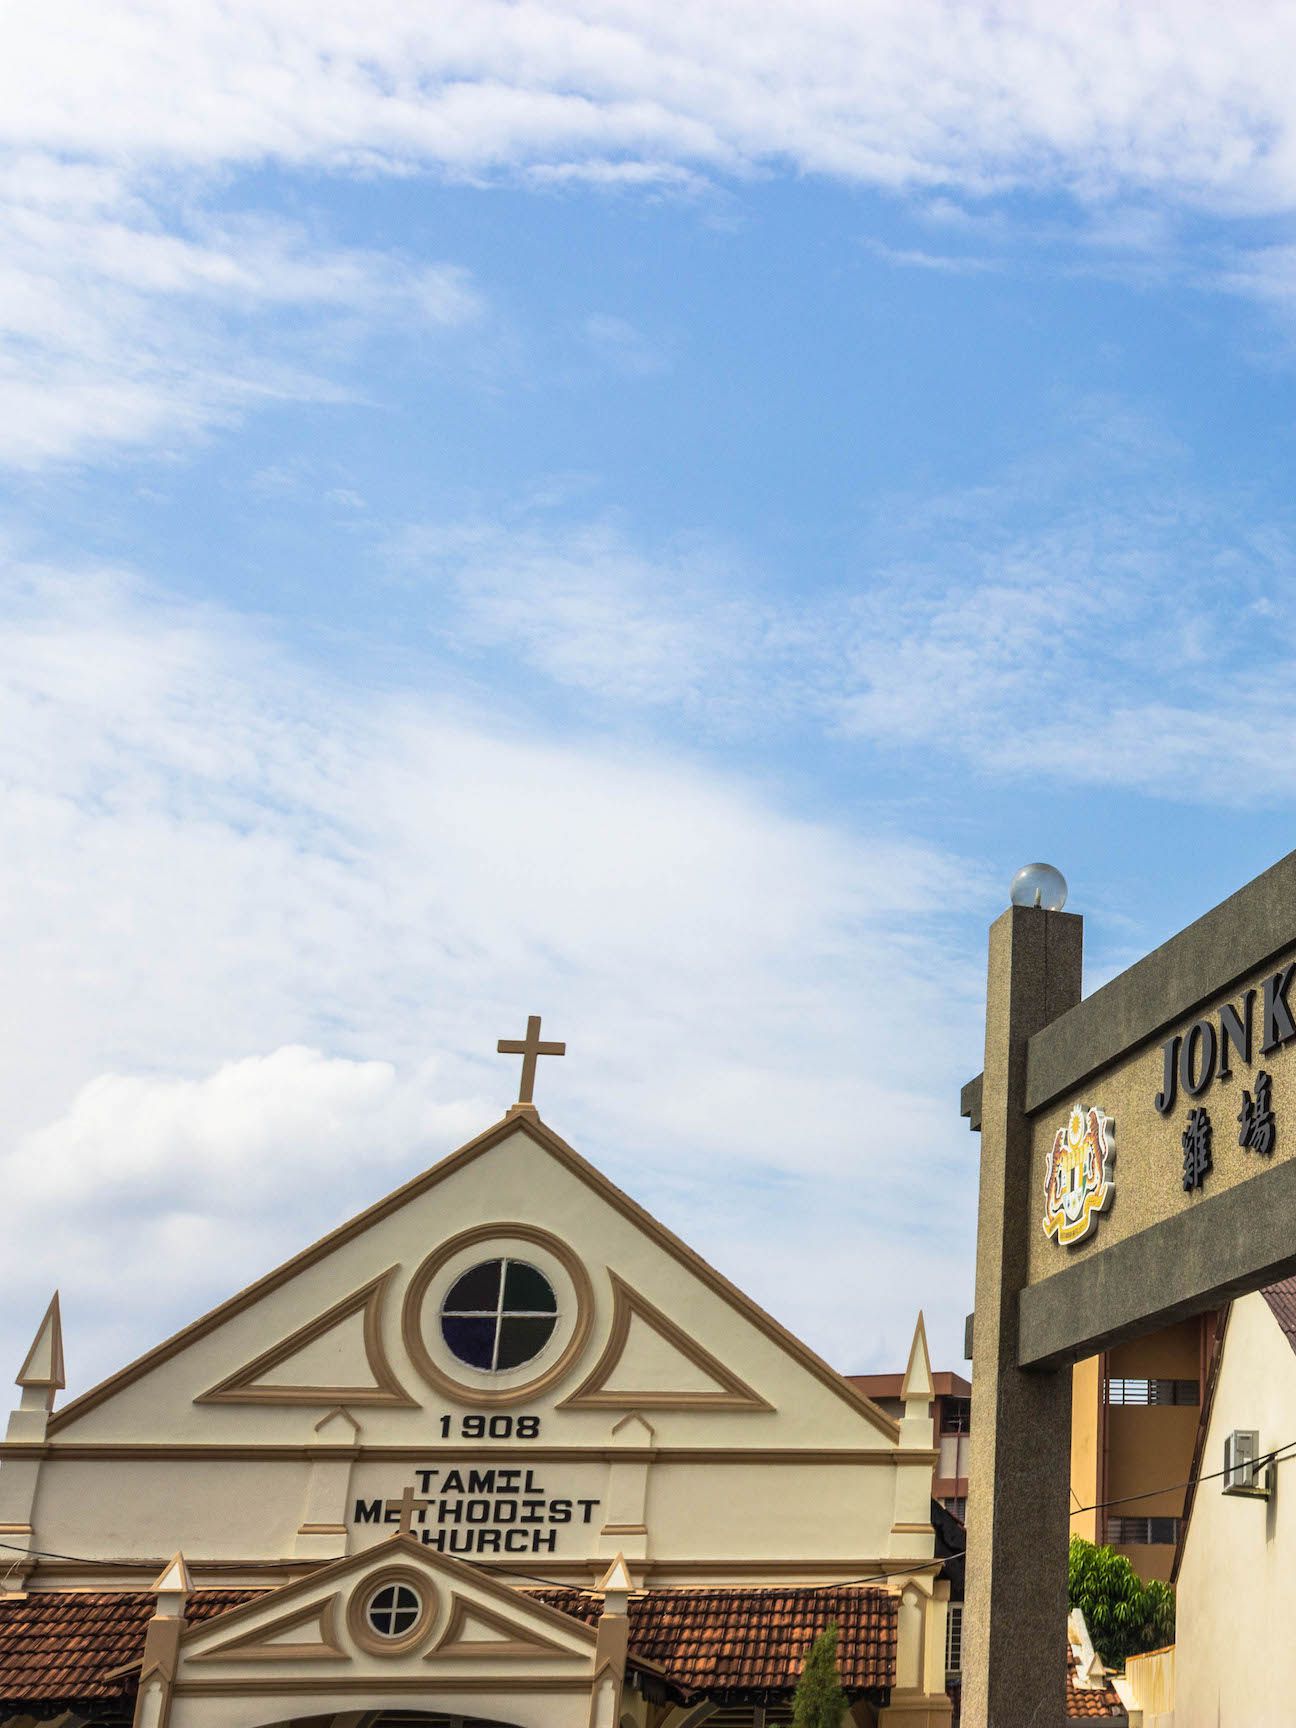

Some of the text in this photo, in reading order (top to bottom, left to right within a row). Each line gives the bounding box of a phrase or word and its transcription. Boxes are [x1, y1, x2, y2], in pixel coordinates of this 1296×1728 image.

[440, 1415, 541, 1439] 1908
[415, 1470, 545, 1494] TAMIL
[395, 1528, 557, 1553] HURCH
